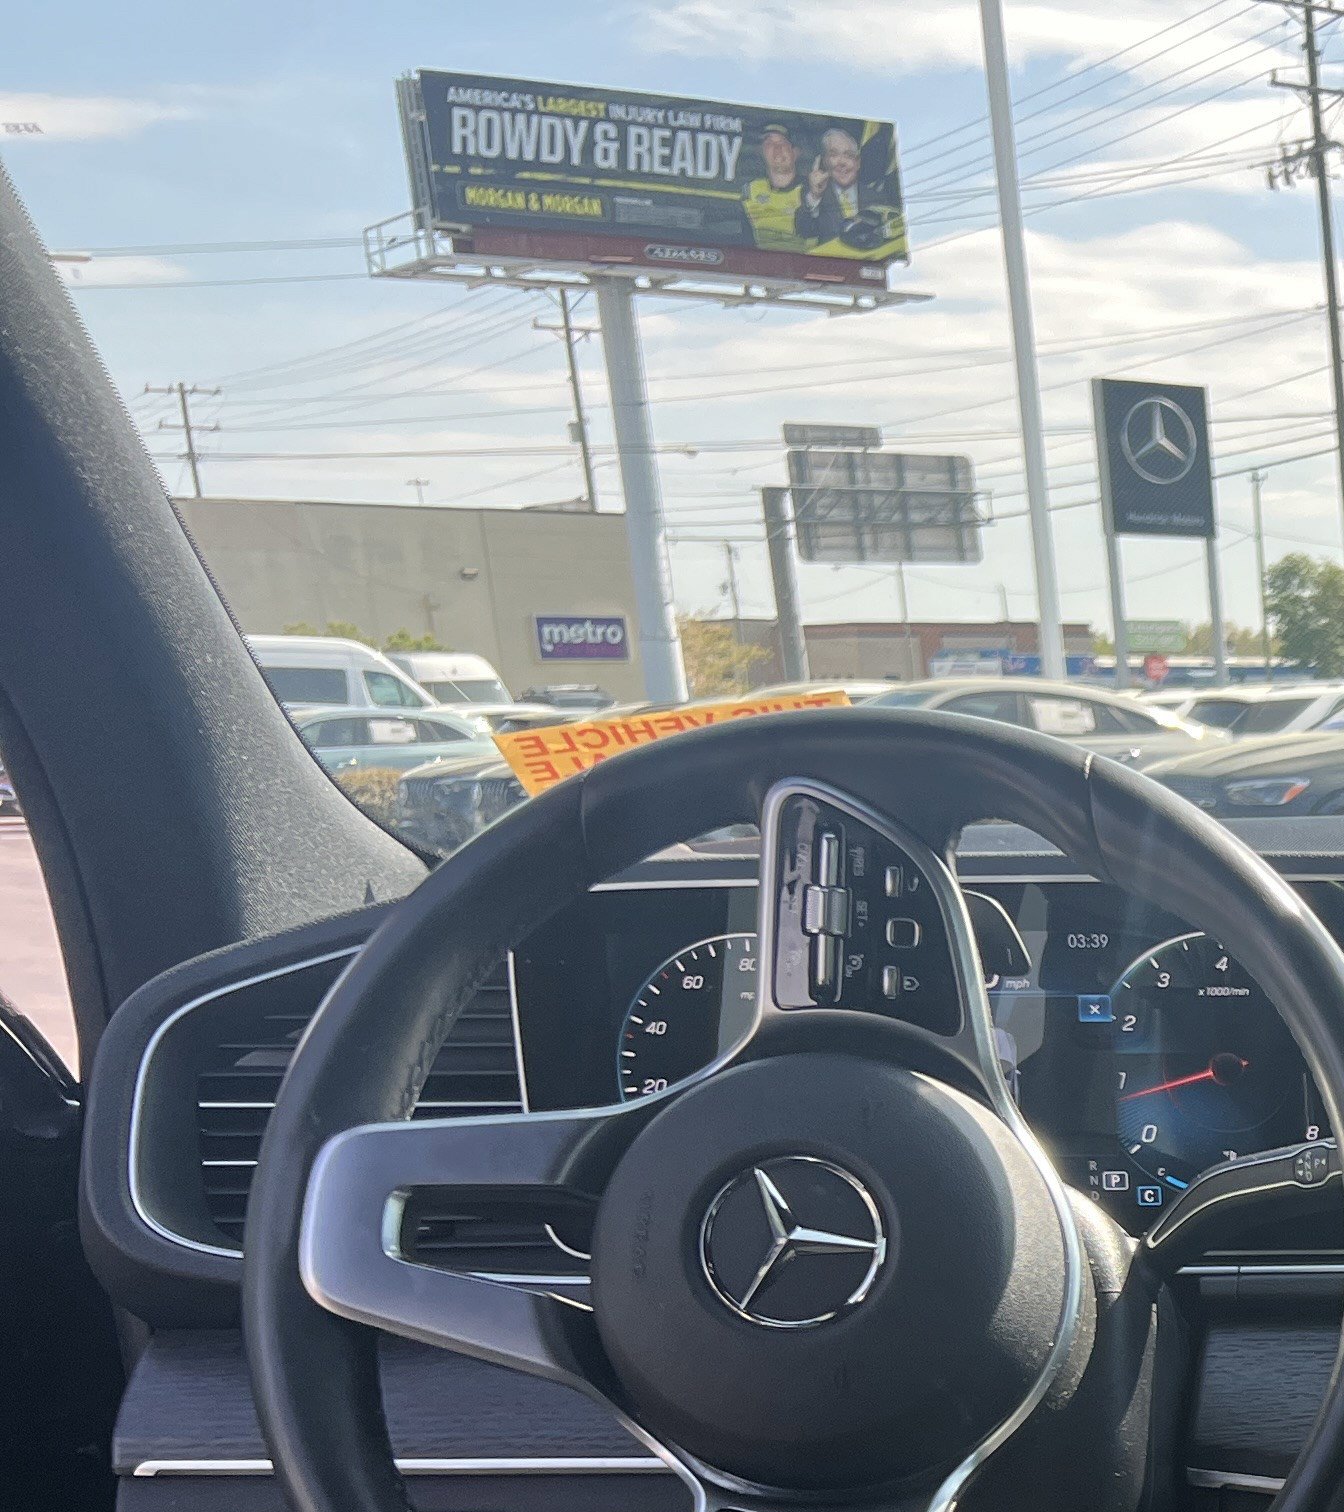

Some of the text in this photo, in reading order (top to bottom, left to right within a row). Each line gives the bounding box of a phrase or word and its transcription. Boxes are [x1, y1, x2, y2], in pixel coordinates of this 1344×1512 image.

[446, 86, 743, 133] AMERICA'S LARGEST INJURY LAW FIRM
[451, 105, 743, 182] ROWDY & READY
[464, 185, 526, 210] MORGAN
[528, 193, 541, 212] &
[542, 194, 603, 216] MORGAN
[543, 619, 623, 651] metro
[1067, 933, 1109, 949] 03:39
[1214, 956, 1229, 972] 4
[682, 975, 704, 990] 60
[1005, 979, 1031, 990] mph
[1156, 972, 1171, 988] 3
[645, 1021, 667, 1035] 40
[1121, 1014, 1137, 1032] 2
[642, 1078, 668, 1095] 20
[1118, 1071, 1127, 1090] 1
[1141, 1124, 1158, 1144] 0
[1305, 1125, 1320, 1141] 8
[1087, 1160, 1098, 1171] R
[1090, 1175, 1099, 1185] N
